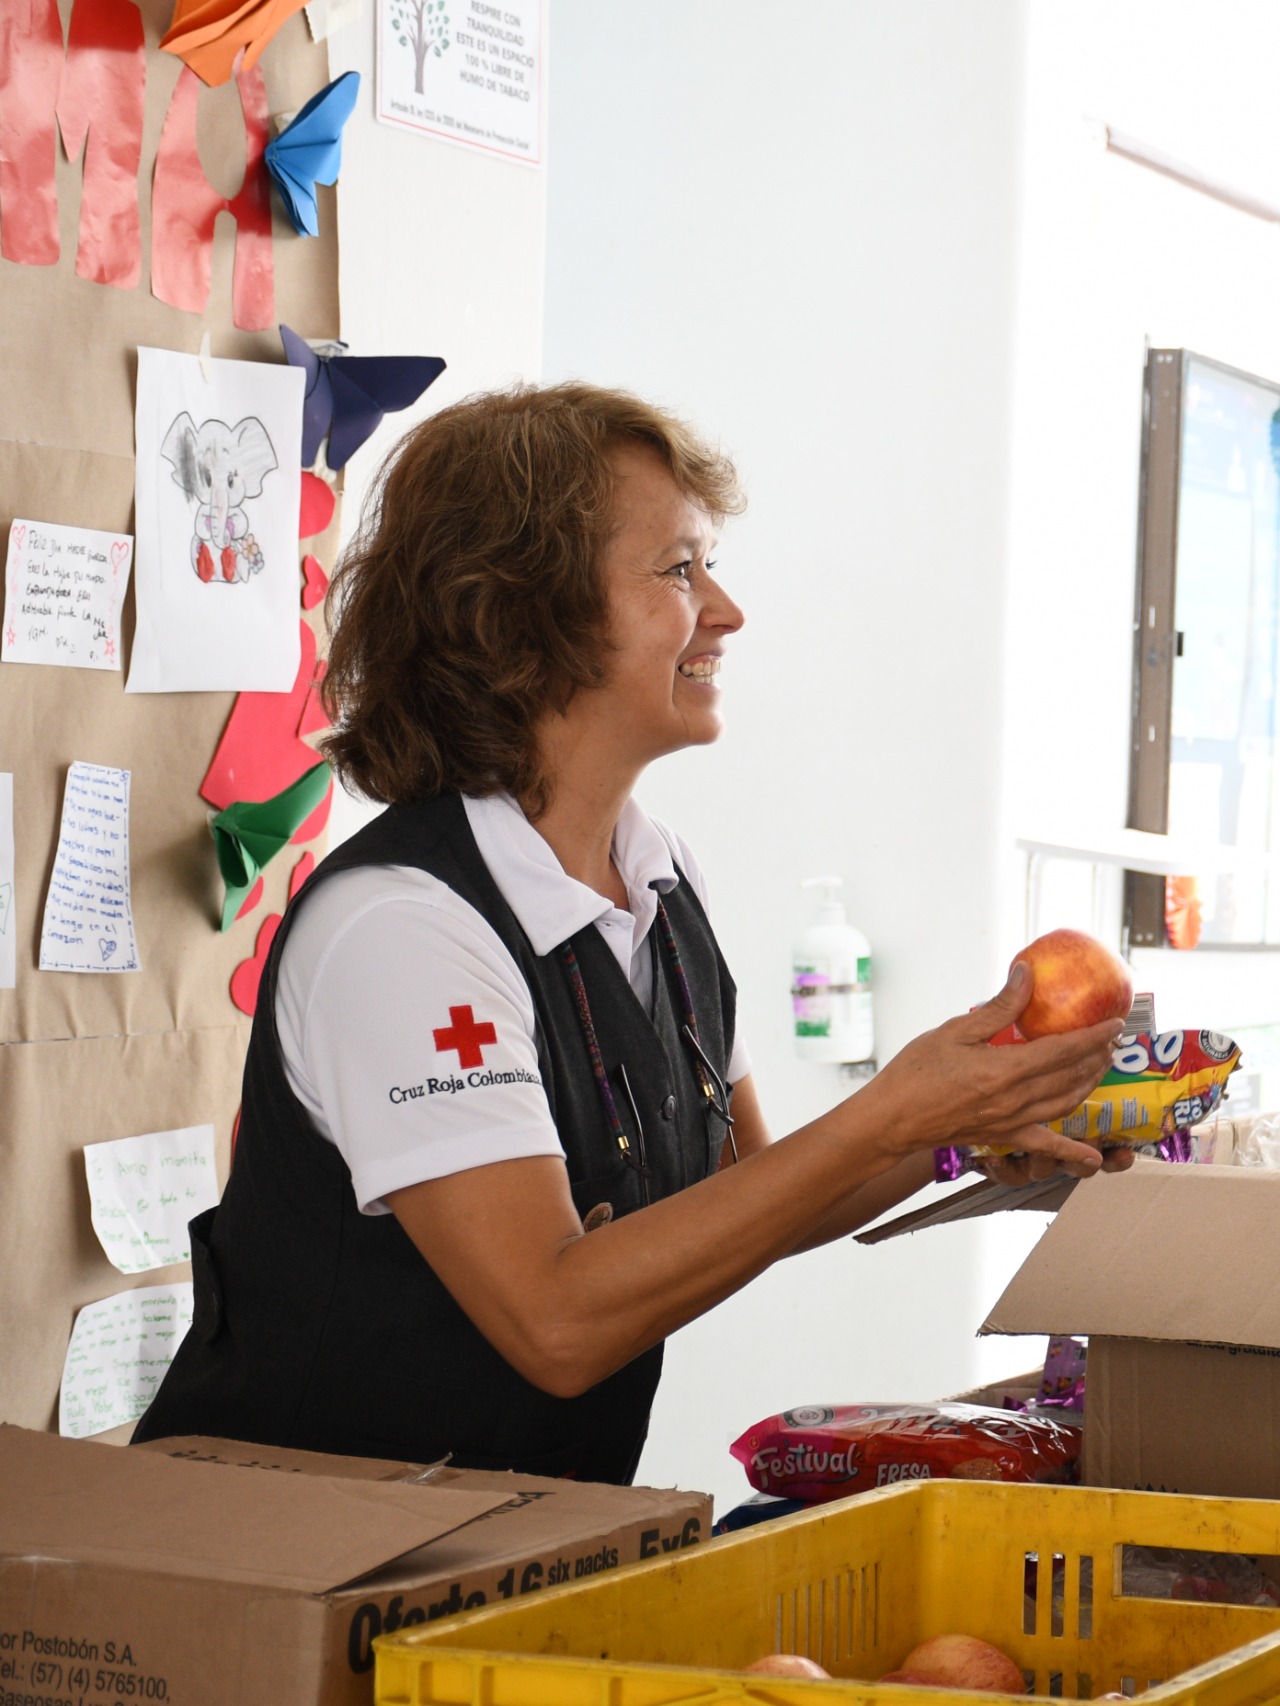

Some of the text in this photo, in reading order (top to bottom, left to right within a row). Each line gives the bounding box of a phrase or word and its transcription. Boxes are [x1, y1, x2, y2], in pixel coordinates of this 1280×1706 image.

[471, 0, 522, 27] RESPIRE CON
[467, 17, 525, 47] TRANQUILIDAD
[456, 32, 535, 69] ESTE ES UN ESPACIO
[465, 53, 480, 68] 100
[491, 62, 512, 79] LIBRE
[515, 70, 525, 83] DE
[459, 70, 531, 102] HUMO DE TABACO
[389, 1085, 425, 1104] Cruz
[426, 1074, 465, 1095] Roja
[751, 1438, 858, 1489] Festival
[876, 1463, 931, 1487] FRESA
[497, 1562, 544, 1600] 16
[548, 1558, 571, 1586] six
[575, 1547, 619, 1578] packs
[22, 1631, 99, 1661] Postobón
[104, 1641, 137, 1667] S.A.
[30, 1661, 63, 1691] (57)
[68, 1666, 91, 1694] (4)
[95, 1669, 171, 1703] 5765100,
